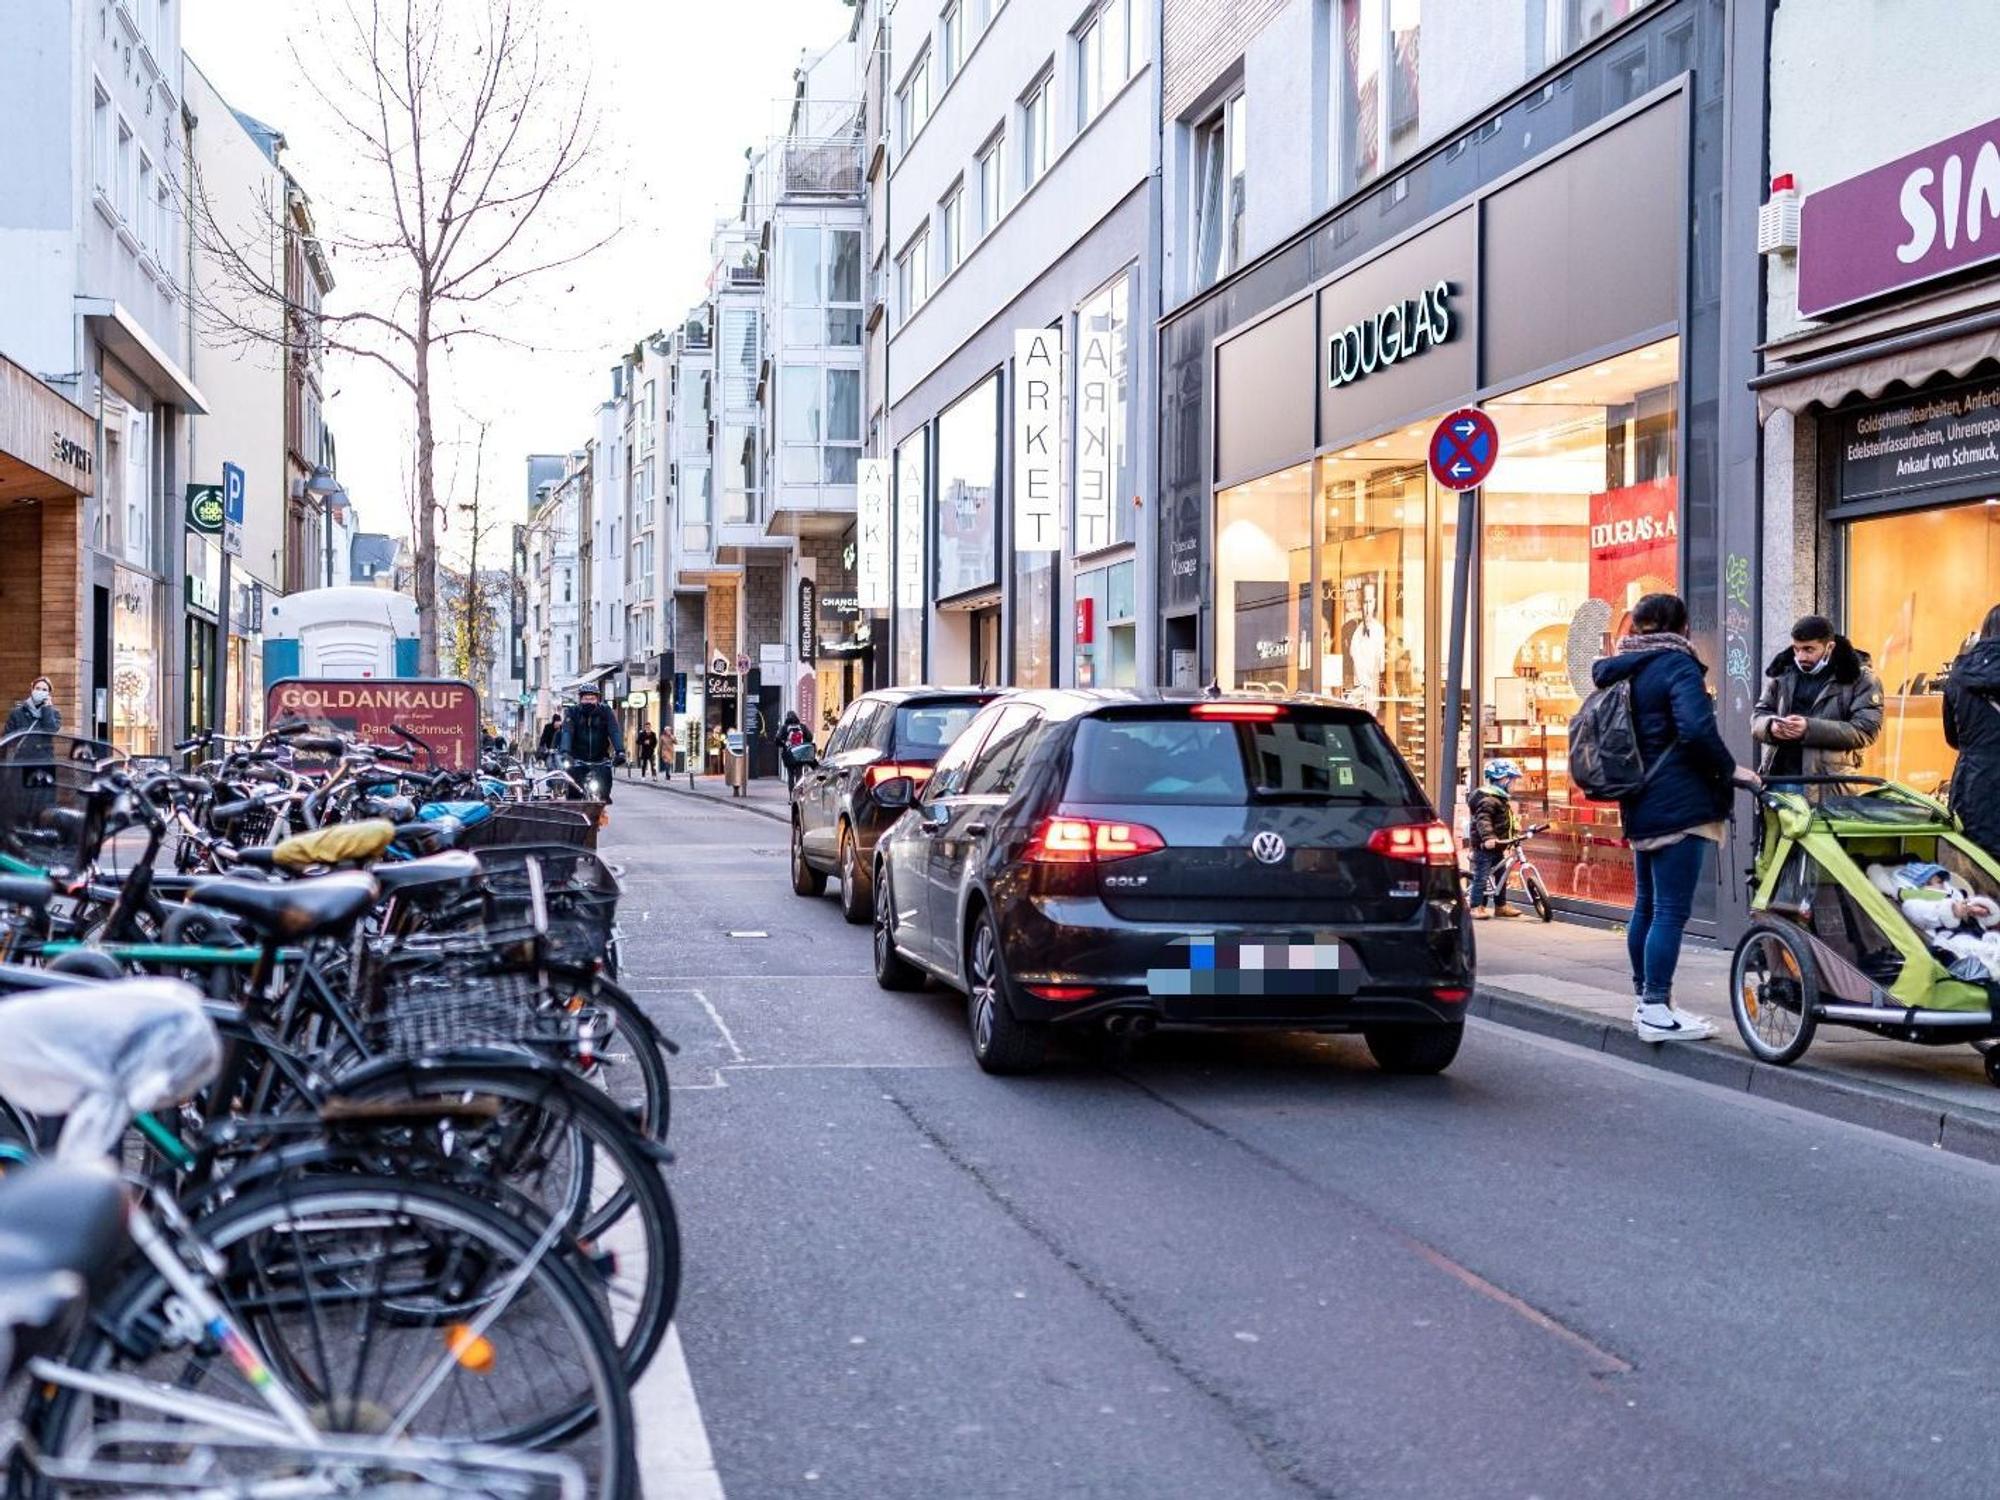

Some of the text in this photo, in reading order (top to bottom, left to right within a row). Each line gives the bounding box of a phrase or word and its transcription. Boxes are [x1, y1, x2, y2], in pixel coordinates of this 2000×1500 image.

[1328, 280, 1449, 389] DOUGLAS
[1857, 399, 1961, 434] Goldschmiedearbeiten,
[1026, 336, 1052, 543] ARKET
[1847, 429, 1945, 461] Edelsteinfassarbeiten,
[1896, 441, 1999, 477] Ankauf von Schmuck,
[229, 471, 240, 513] P
[865, 464, 881, 602] ARKET
[1591, 515, 1653, 549] DOUGLAS
[1654, 520, 1665, 538] x
[822, 597, 859, 606] CHANGE
[281, 689, 464, 709] GOLDANKAUF
[405, 723, 464, 735] Schmuck
[435, 744, 449, 755] 29
[1105, 876, 1148, 887] GOLF
